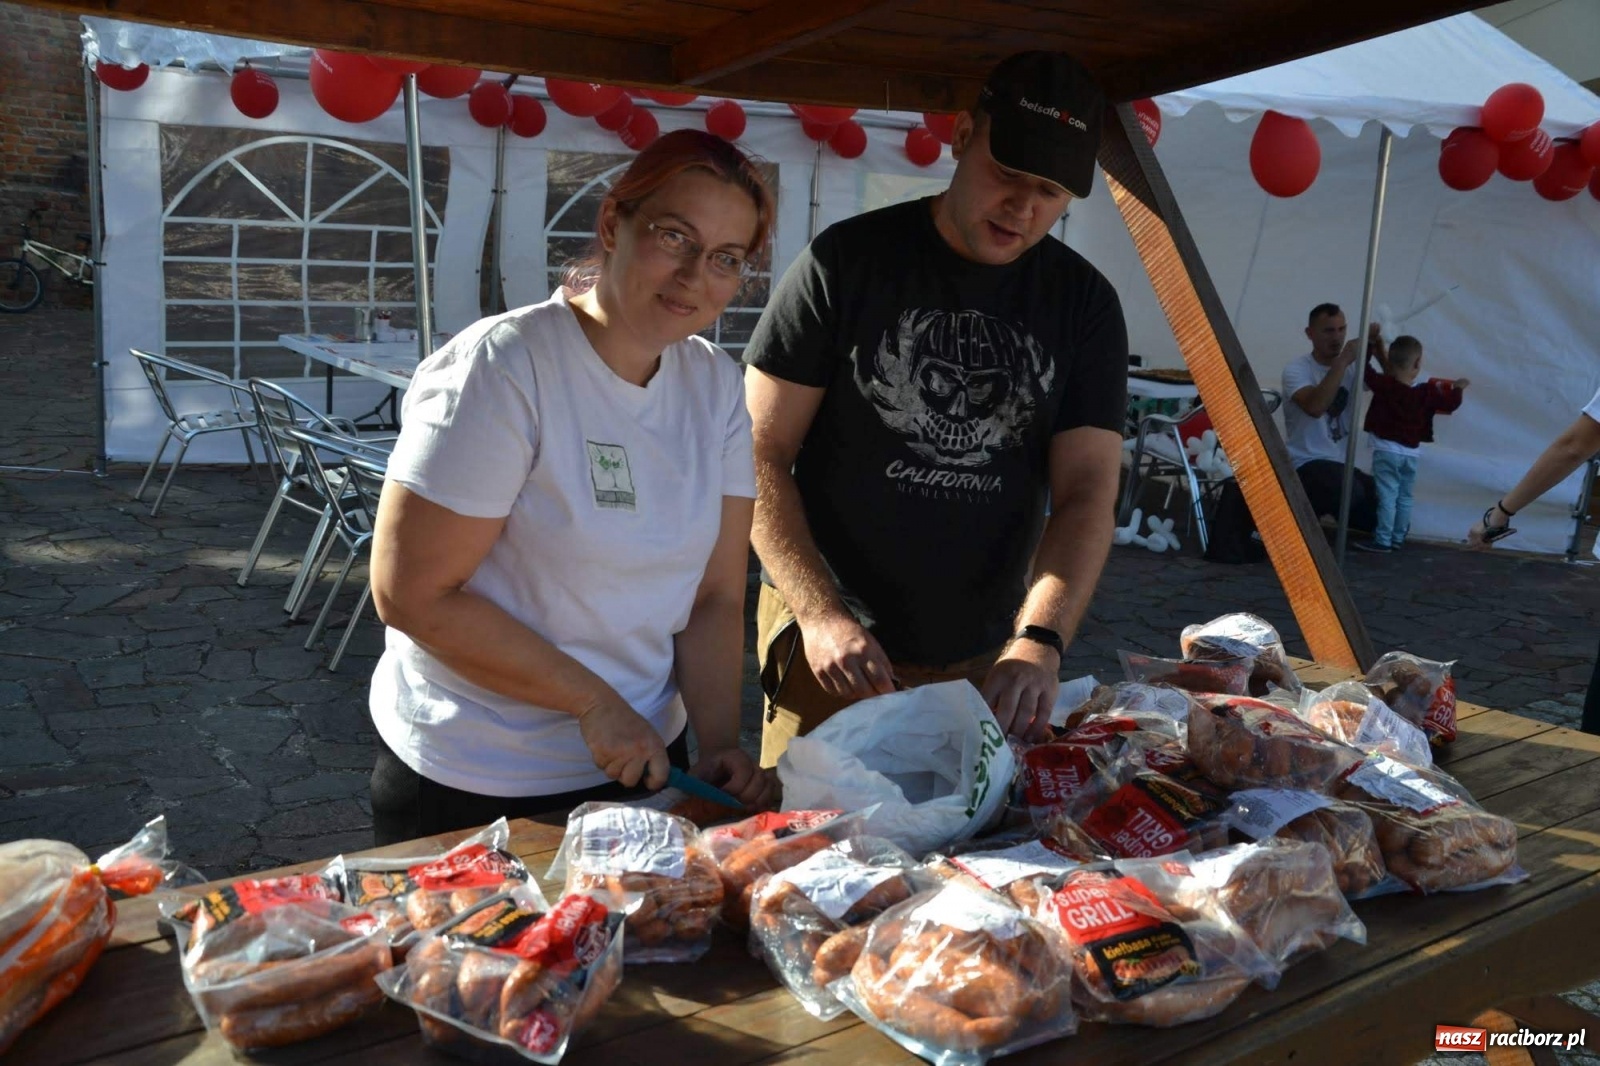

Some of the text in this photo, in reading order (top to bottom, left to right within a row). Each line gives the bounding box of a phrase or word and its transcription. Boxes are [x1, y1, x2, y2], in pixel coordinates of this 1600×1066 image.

[885, 459, 1002, 492] CALIFORNIA
[1036, 766, 1056, 799] super
[1111, 828, 1153, 858] super
[1126, 806, 1174, 851] GRILL
[1055, 886, 1109, 907] super
[1066, 898, 1136, 930] GRILL
